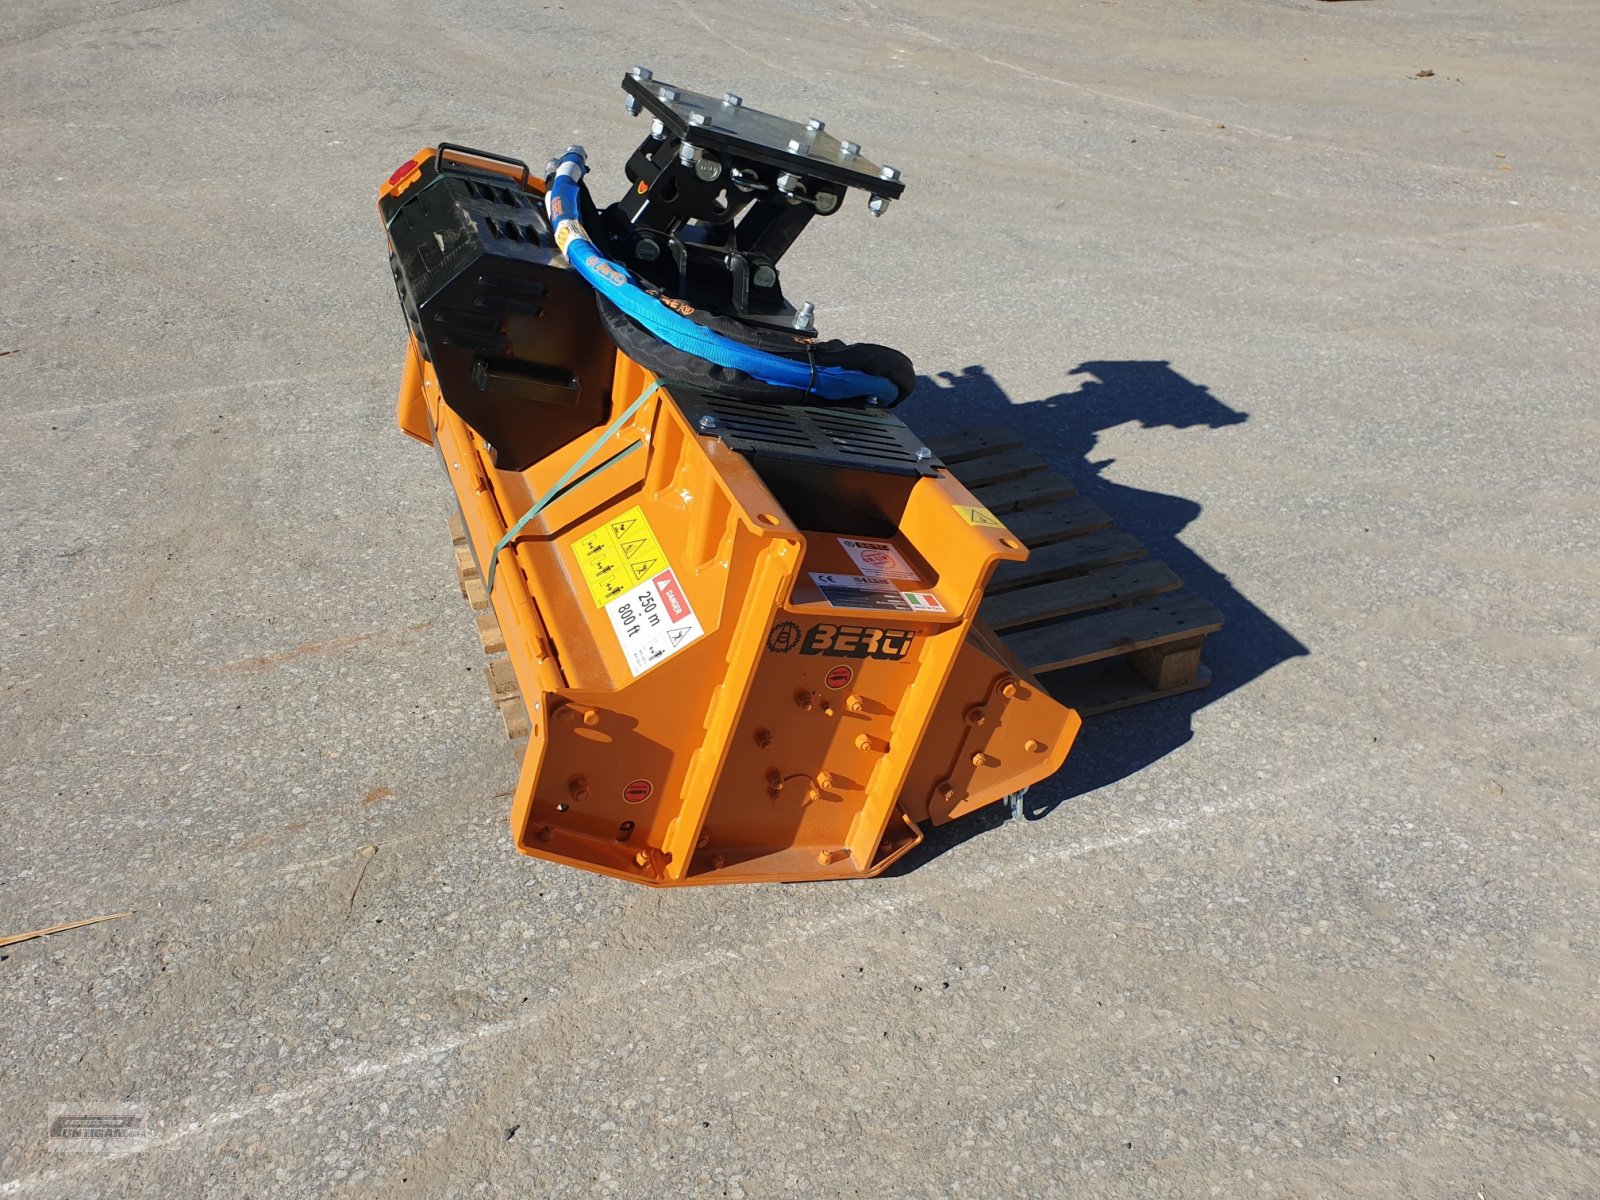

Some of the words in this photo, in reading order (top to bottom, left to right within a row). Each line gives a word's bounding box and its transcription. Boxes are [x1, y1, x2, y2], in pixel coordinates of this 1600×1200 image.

[618, 603, 636, 626] 800
[627, 624, 641, 638] ft
[638, 591, 656, 614] 250
[648, 613, 660, 627] m
[666, 590, 683, 616] DANGER
